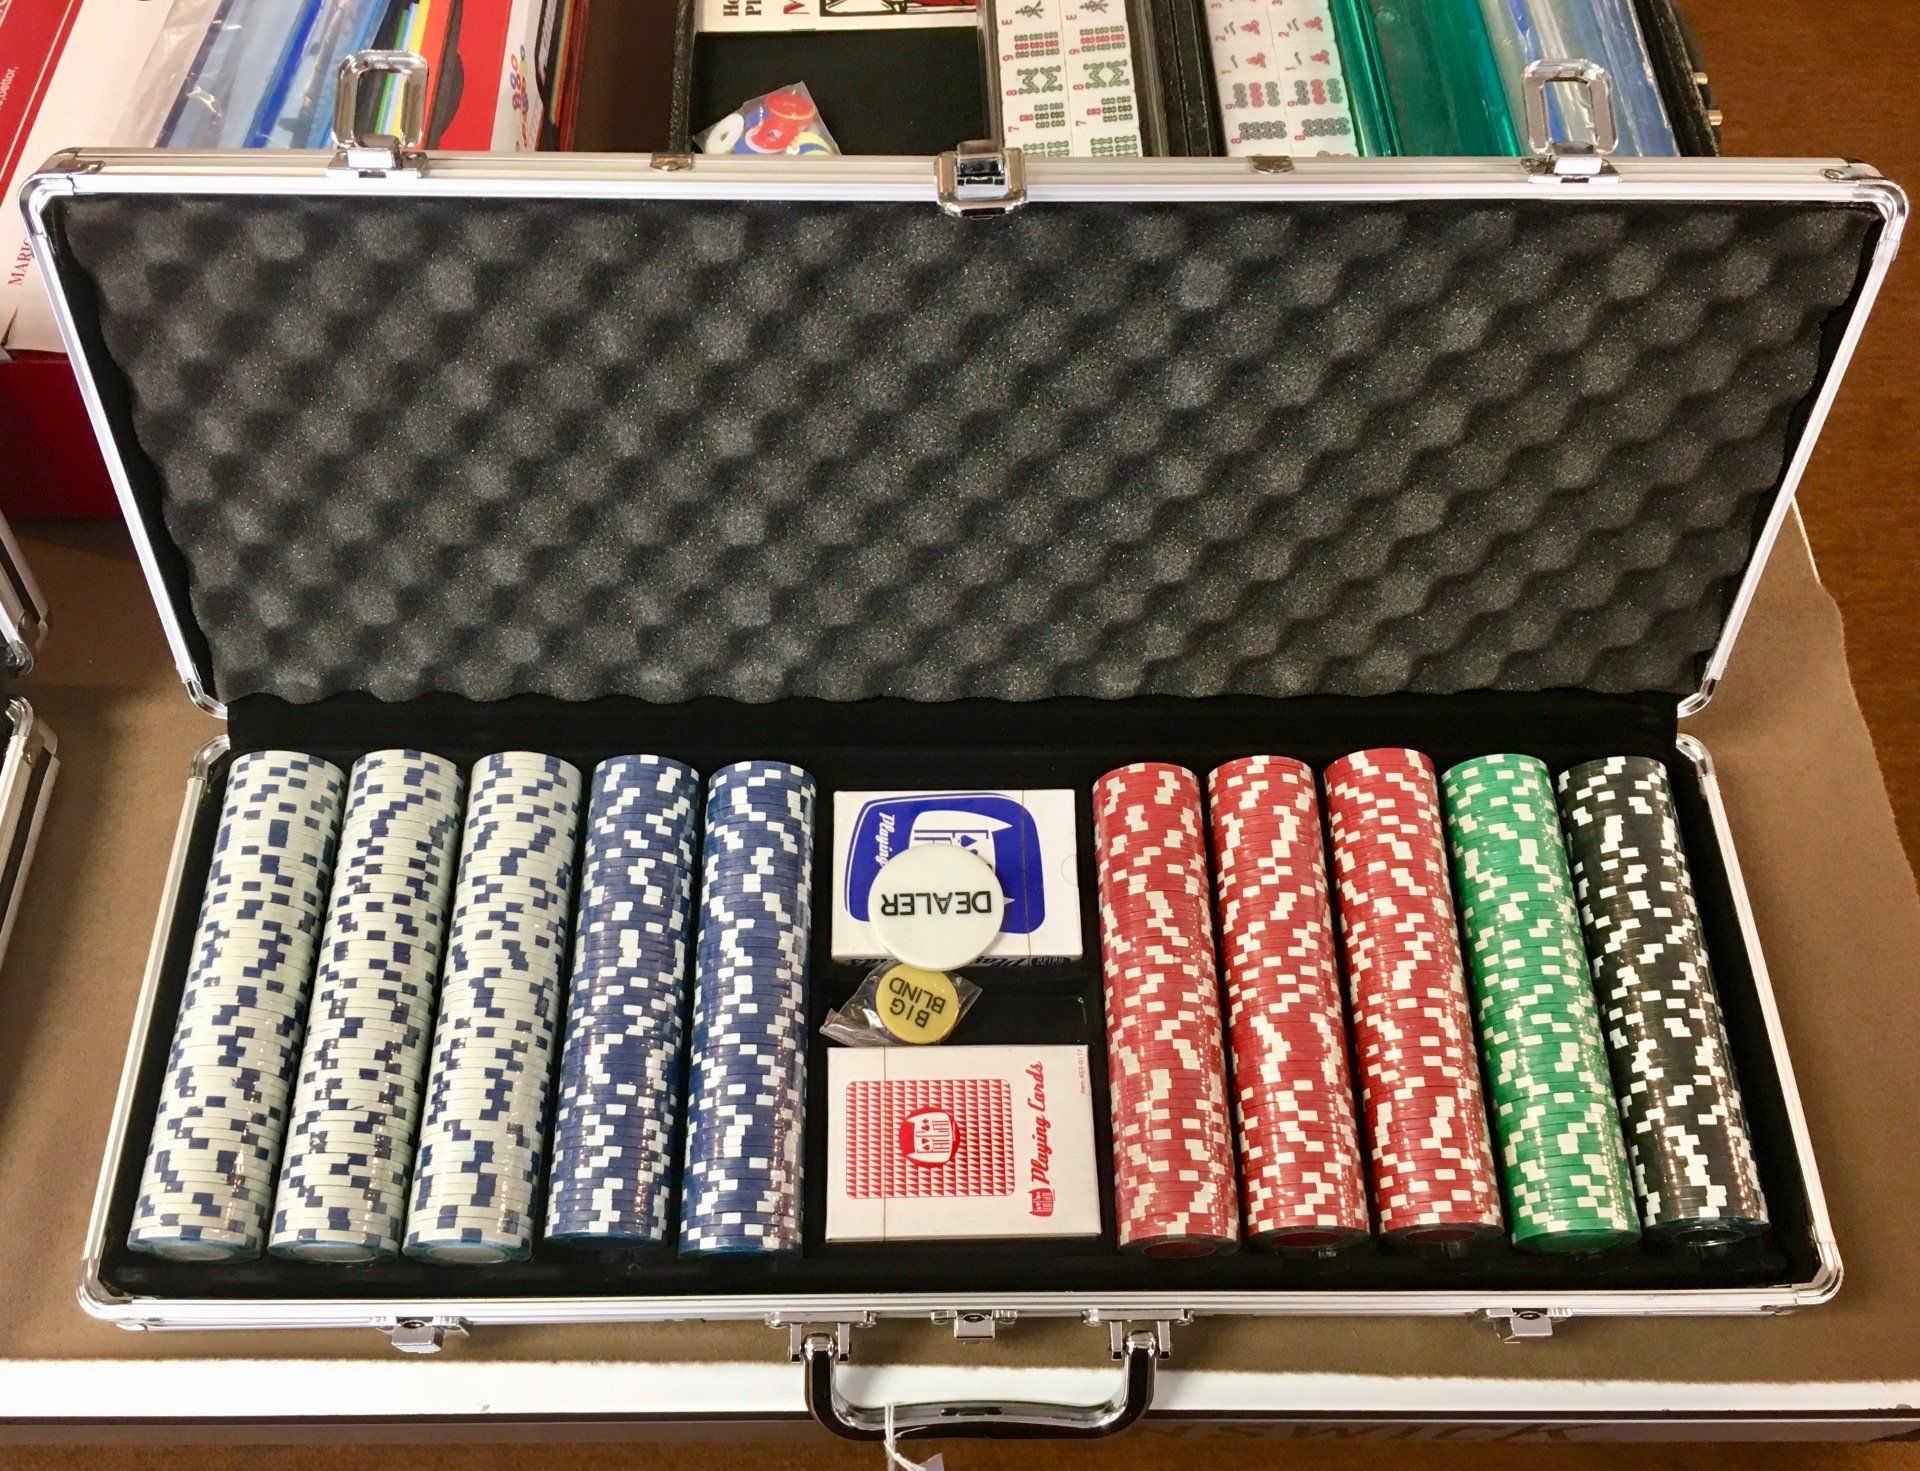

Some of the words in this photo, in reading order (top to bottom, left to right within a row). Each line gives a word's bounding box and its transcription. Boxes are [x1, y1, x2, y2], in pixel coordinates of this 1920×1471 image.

[1002, 54, 1014, 62] 9
[1068, 48, 1080, 56] 9
[1006, 89, 1018, 97] 8
[1072, 83, 1084, 91] 8
[880, 890, 993, 916] DEALER
[888, 976, 947, 1015] BLIND
[889, 998, 931, 1029] BIG
[1025, 1060, 1046, 1113] Cards
[1030, 1113, 1053, 1186] Playing
